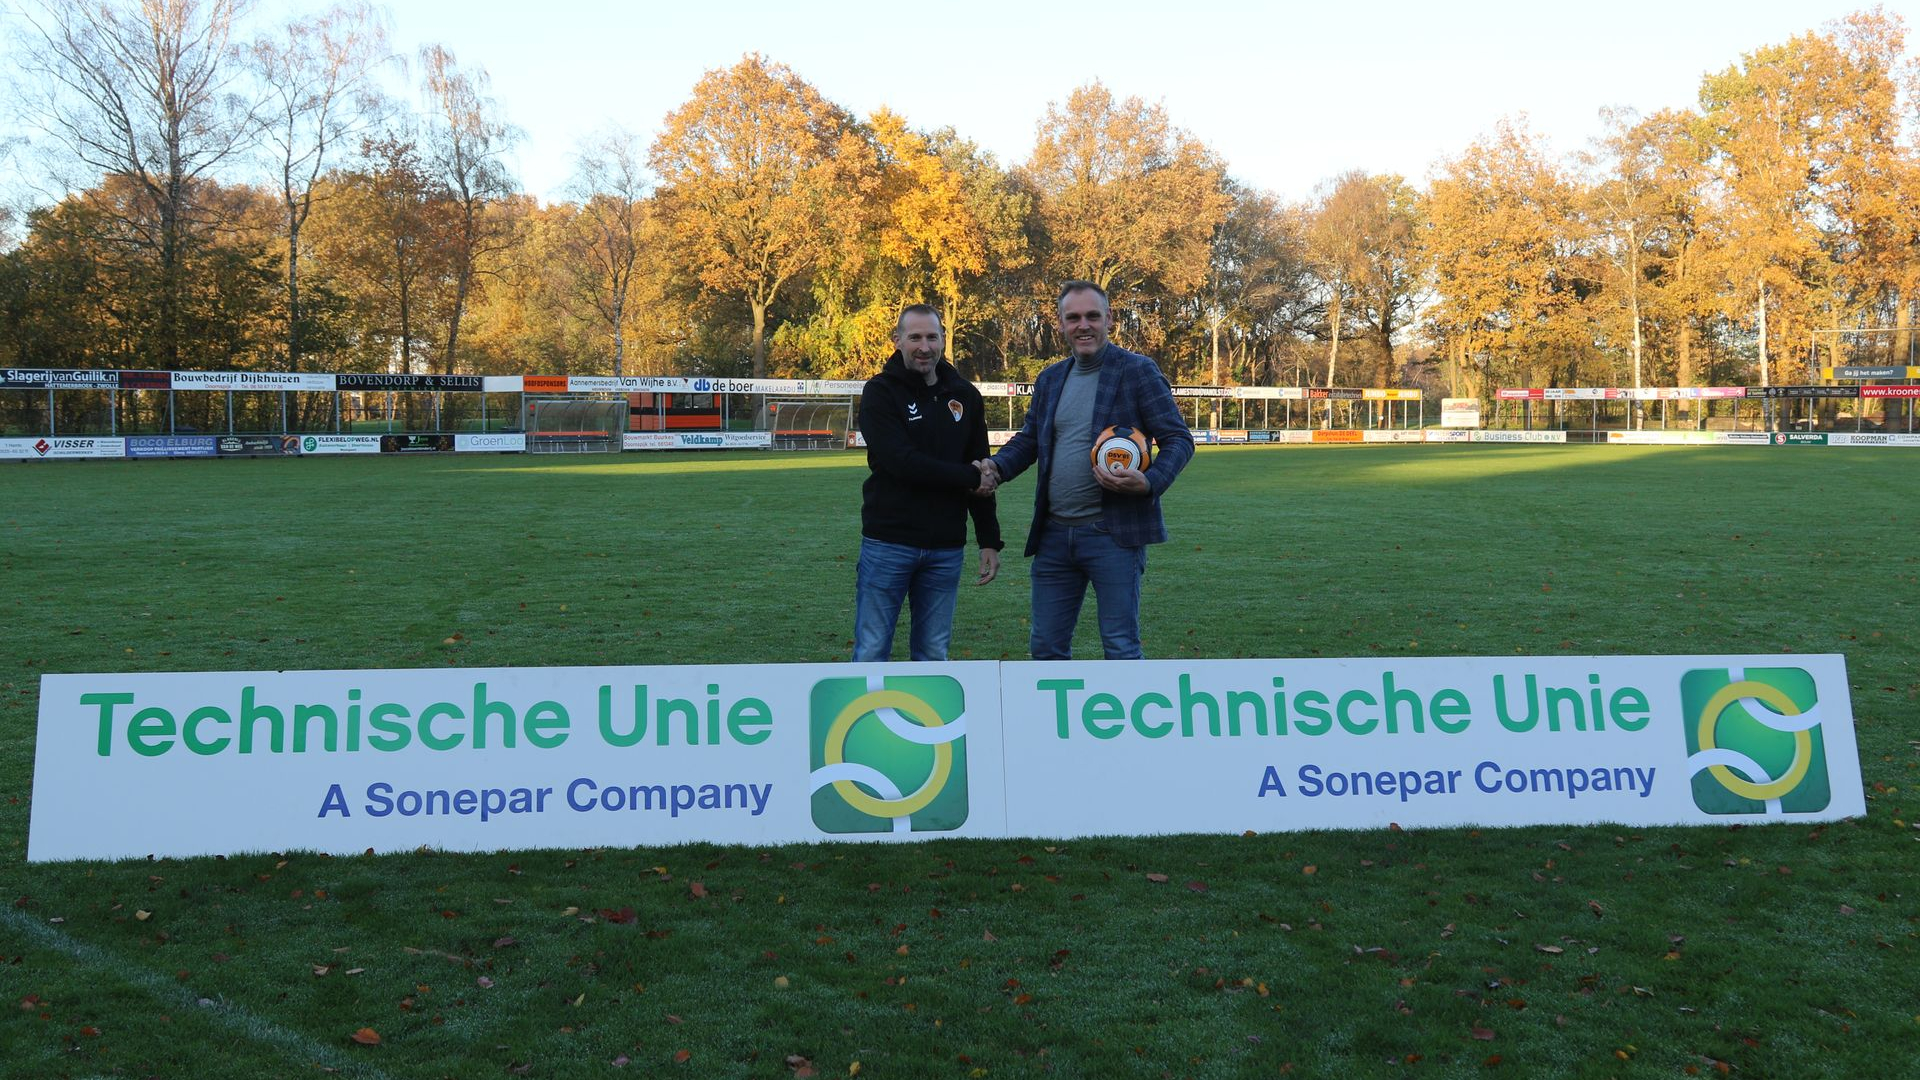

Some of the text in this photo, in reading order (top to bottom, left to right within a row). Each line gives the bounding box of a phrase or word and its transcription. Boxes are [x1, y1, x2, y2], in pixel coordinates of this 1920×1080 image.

[7, 370, 119, 383] SlagerijvanGuilik.nl
[174, 373, 237, 383] Bouwbedrijf
[241, 374, 300, 384] Dijkhuizen
[339, 376, 419, 386] BOVENDORP
[425, 377, 434, 386] &
[440, 378, 479, 386] SELLIS
[619, 377, 638, 387] Van
[639, 378, 664, 388] Wijhe
[712, 379, 726, 391] de
[729, 379, 754, 391] boer
[681, 435, 723, 447] Veldkamp
[1484, 432, 1521, 441] Business
[1525, 431, 1542, 440] Club
[1789, 434, 1823, 442] SALVERDA
[54, 440, 95, 448] VISSER
[130, 438, 213, 446] BOCO ELBURG
[1035, 670, 1653, 740] Technische Unie
[79, 681, 774, 758] Technische Unie
[1257, 760, 1657, 802] A Sonepar Company
[318, 778, 774, 822] A Sonepar Company
